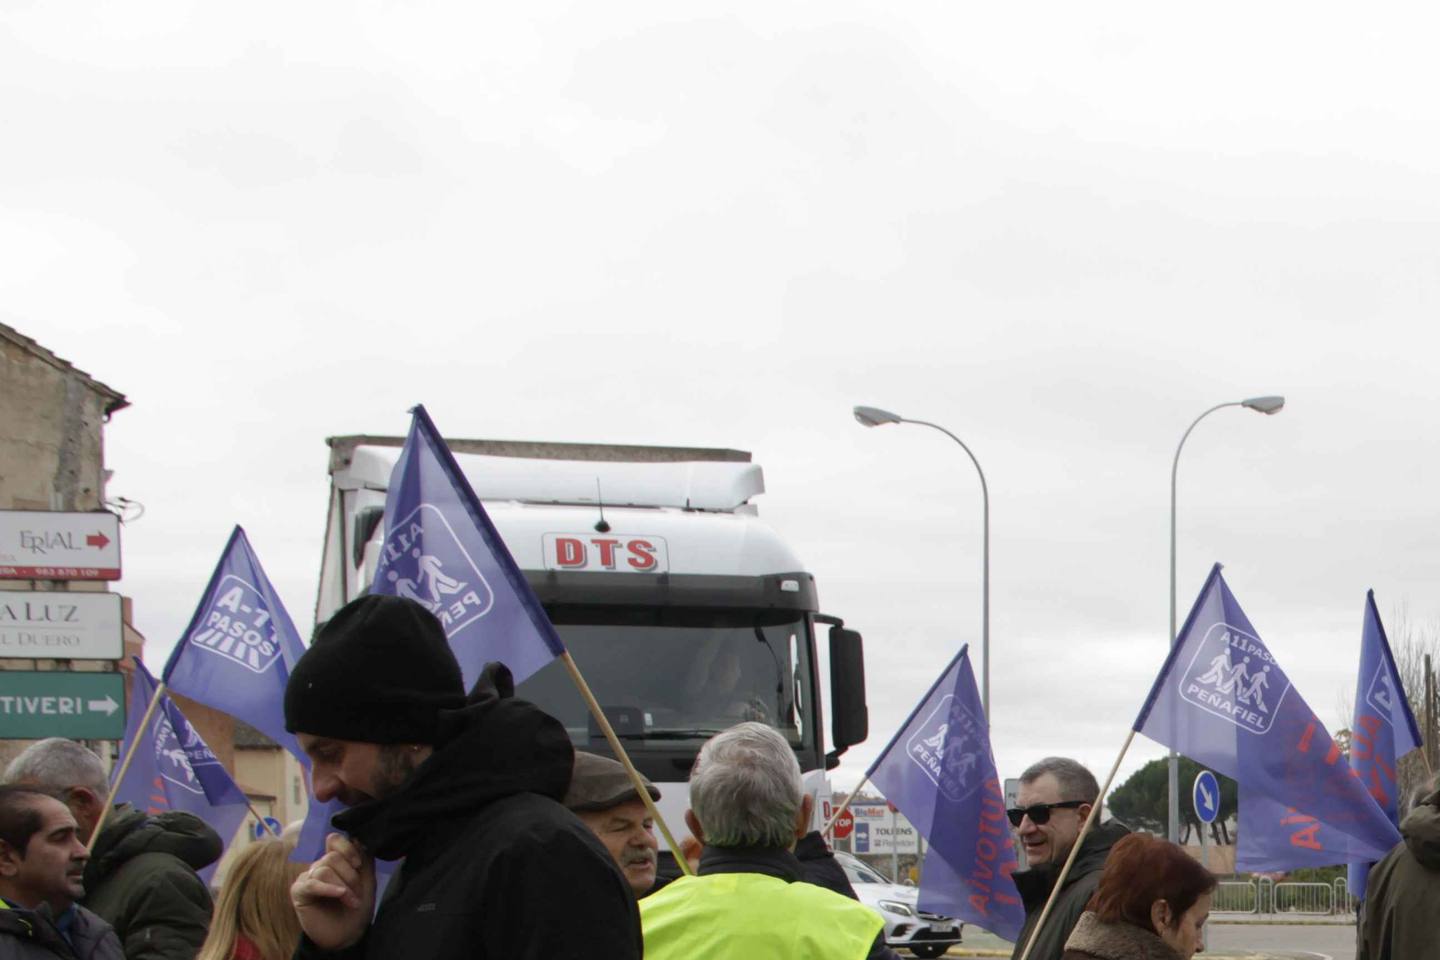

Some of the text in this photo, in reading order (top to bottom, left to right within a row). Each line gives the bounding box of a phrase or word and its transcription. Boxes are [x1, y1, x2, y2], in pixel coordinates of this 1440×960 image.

[20, 529, 83, 555] ERIAL
[555, 537, 658, 571] DTS
[24, 602, 80, 622] LUZ
[18, 632, 80, 647] DUERO
[206, 610, 275, 657] PASOS
[0, 696, 83, 715] TIVERI
[1187, 683, 1265, 729] PEÑAFIEL
[833, 818, 852, 828] TOP
